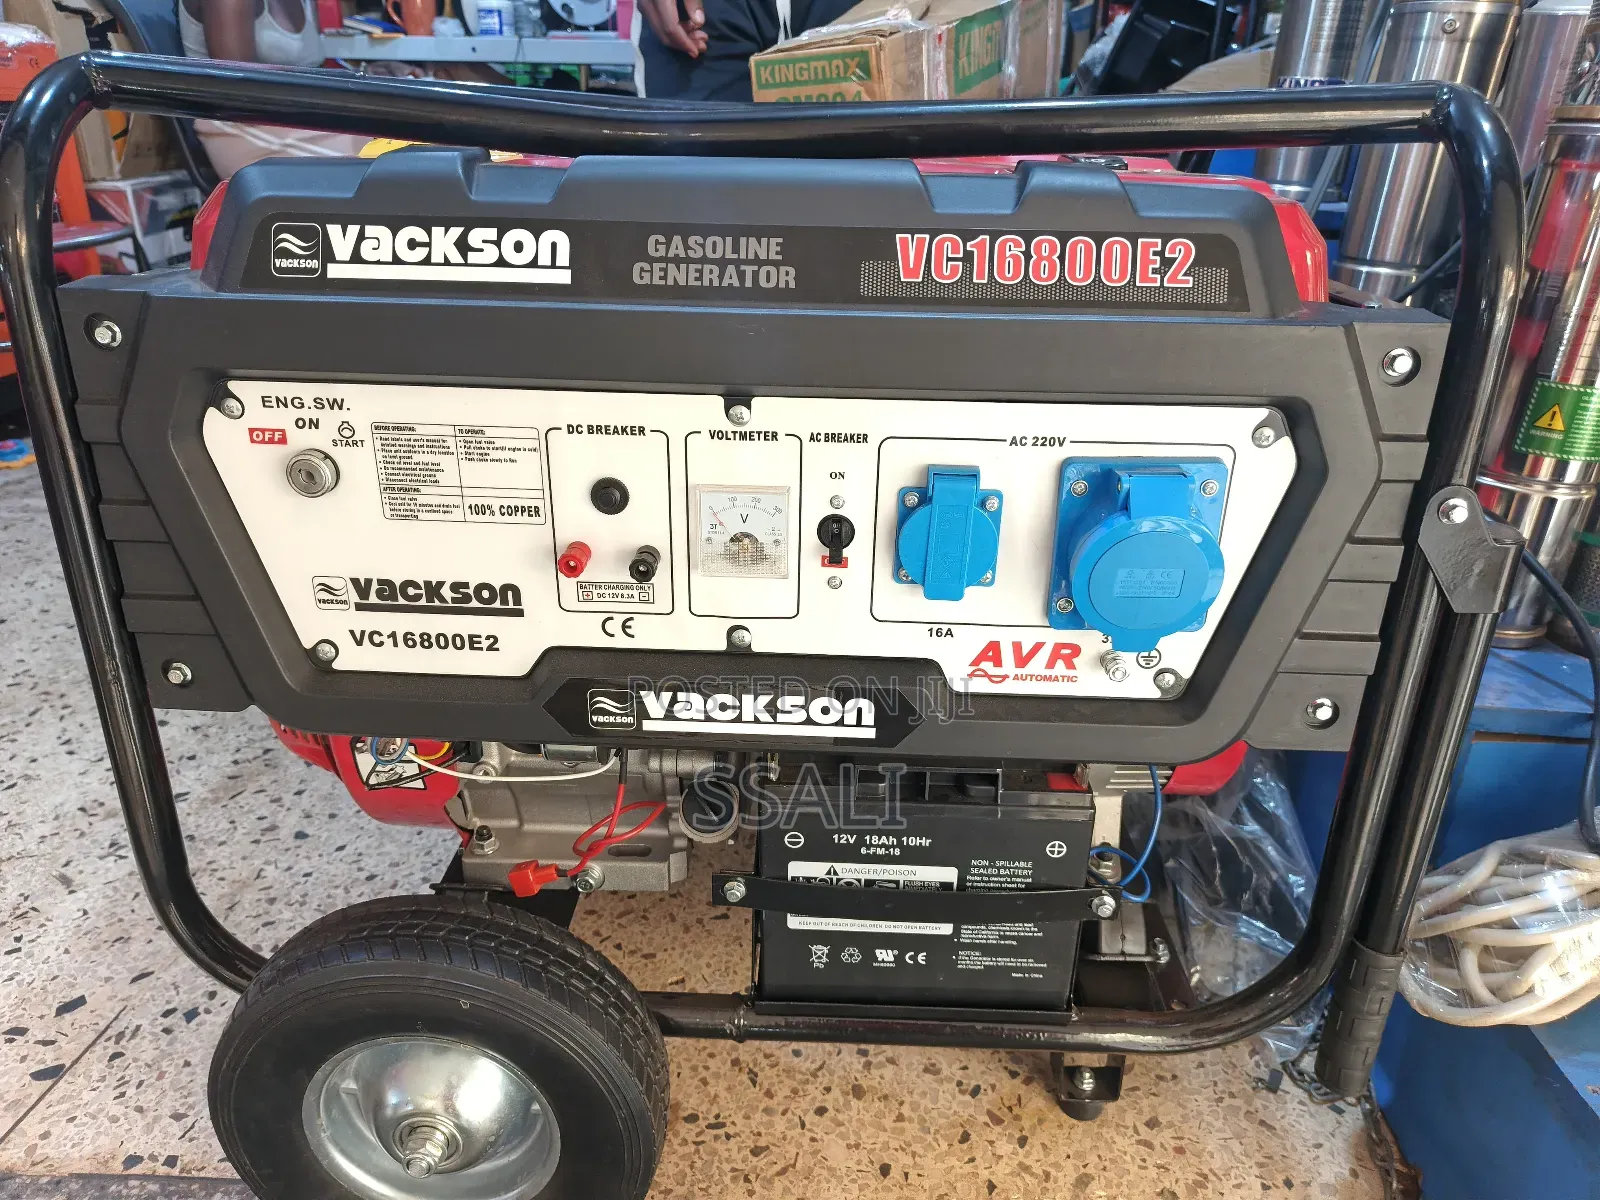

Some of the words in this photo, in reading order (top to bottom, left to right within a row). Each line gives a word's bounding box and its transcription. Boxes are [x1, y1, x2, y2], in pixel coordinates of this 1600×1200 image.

[647, 234, 784, 260] GASOLINE
[895, 233, 1197, 290] VC16800E2
[632, 261, 797, 289] GENERATOR
[260, 395, 351, 411] ENG.SW.
[294, 417, 320, 430] ON
[566, 423, 585, 435] DC
[587, 424, 647, 437] BREAKER
[252, 430, 283, 442] OFF
[708, 429, 779, 442] VOLTMETER
[808, 431, 822, 443] AC
[824, 432, 869, 444] BREAKER
[1529, 428, 1564, 440] WARNING
[331, 438, 365, 448] START
[1008, 435, 1028, 447] AC
[1031, 436, 1067, 448] 220V
[829, 471, 846, 480] ON
[467, 503, 496, 517] 100%
[498, 504, 541, 518] COPPER
[739, 512, 749, 524] V
[579, 583, 603, 591] BATTER
[635, 584, 651, 592] ONLY
[601, 616, 635, 639] CE
[926, 627, 954, 639] 16A
[348, 629, 501, 652] VC16800E2
[968, 640, 1083, 670] AVR
[1011, 673, 1078, 684] AUTOMATIC
[832, 833, 857, 844] 12V
[864, 834, 897, 846] 18Ah
[901, 836, 932, 847] 10Hr
[860, 846, 901, 856] 6-FM-18
[995, 860, 1033, 868] SPILLABLE
[840, 866, 918, 877] DANGER/POISON
[970, 867, 998, 875] SEALED
[999, 868, 1034, 876] BATTERY
[905, 951, 927, 965] CE
